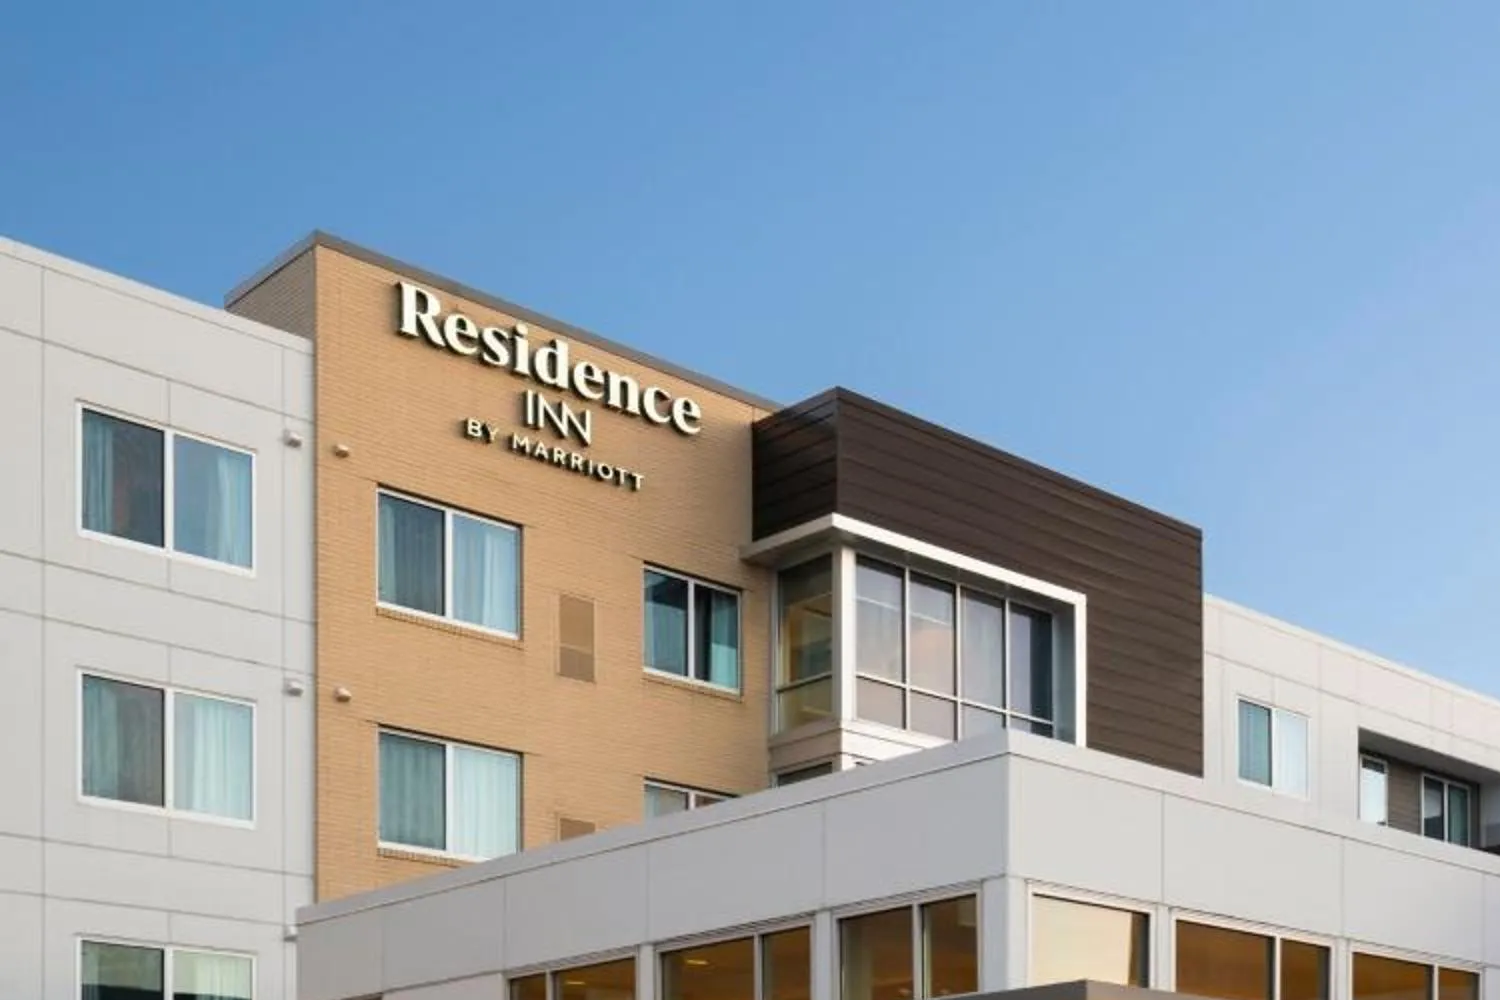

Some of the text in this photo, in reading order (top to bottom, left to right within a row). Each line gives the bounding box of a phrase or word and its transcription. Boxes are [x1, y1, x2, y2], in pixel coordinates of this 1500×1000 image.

[399, 282, 702, 434] Residence
[523, 389, 592, 445] INN
[465, 418, 645, 491] BY MARRIOTT
